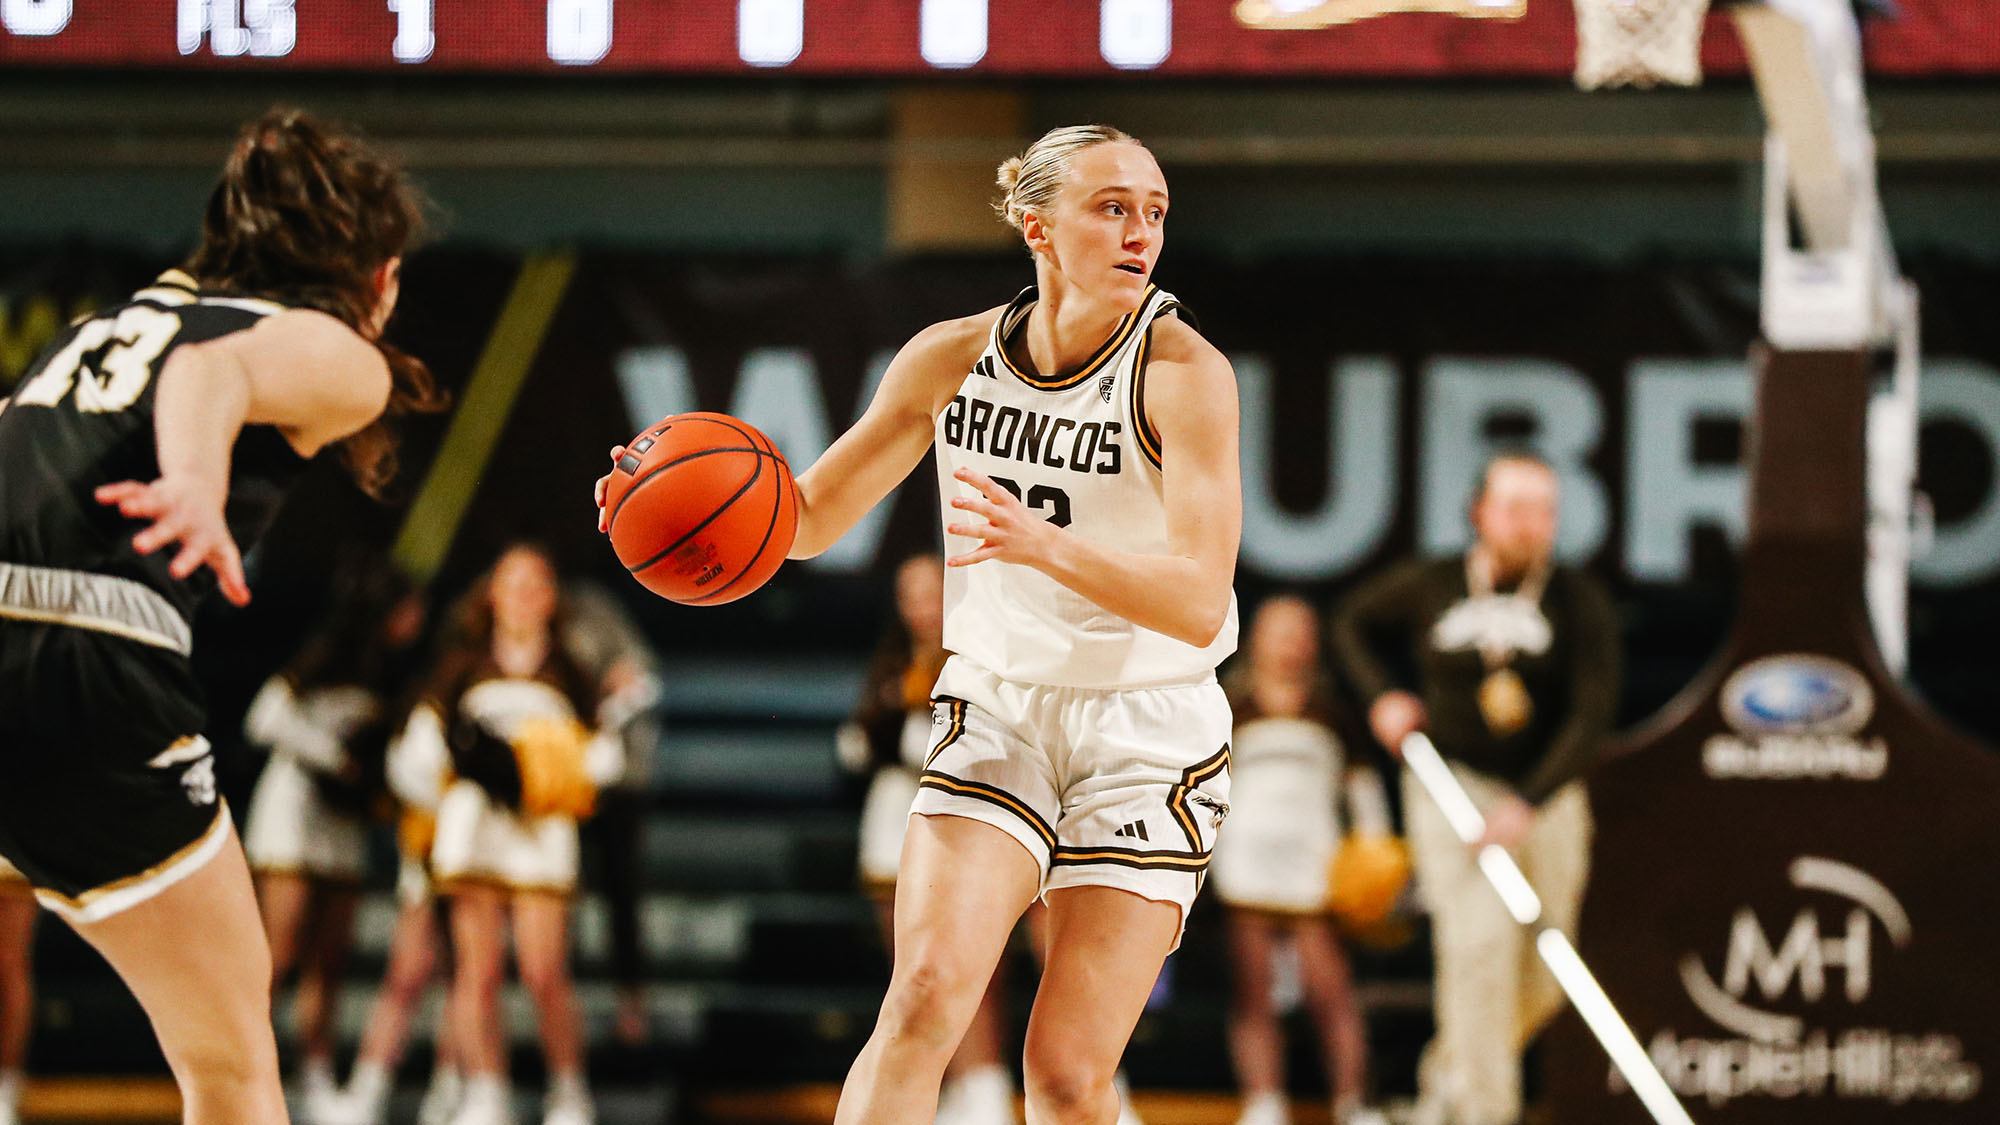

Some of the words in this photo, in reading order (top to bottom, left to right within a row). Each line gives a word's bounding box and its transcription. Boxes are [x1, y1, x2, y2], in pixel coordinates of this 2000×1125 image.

[14, 304, 182, 413] 13
[944, 394, 1122, 475] BRONCOS
[1722, 906, 1872, 1002] MH
